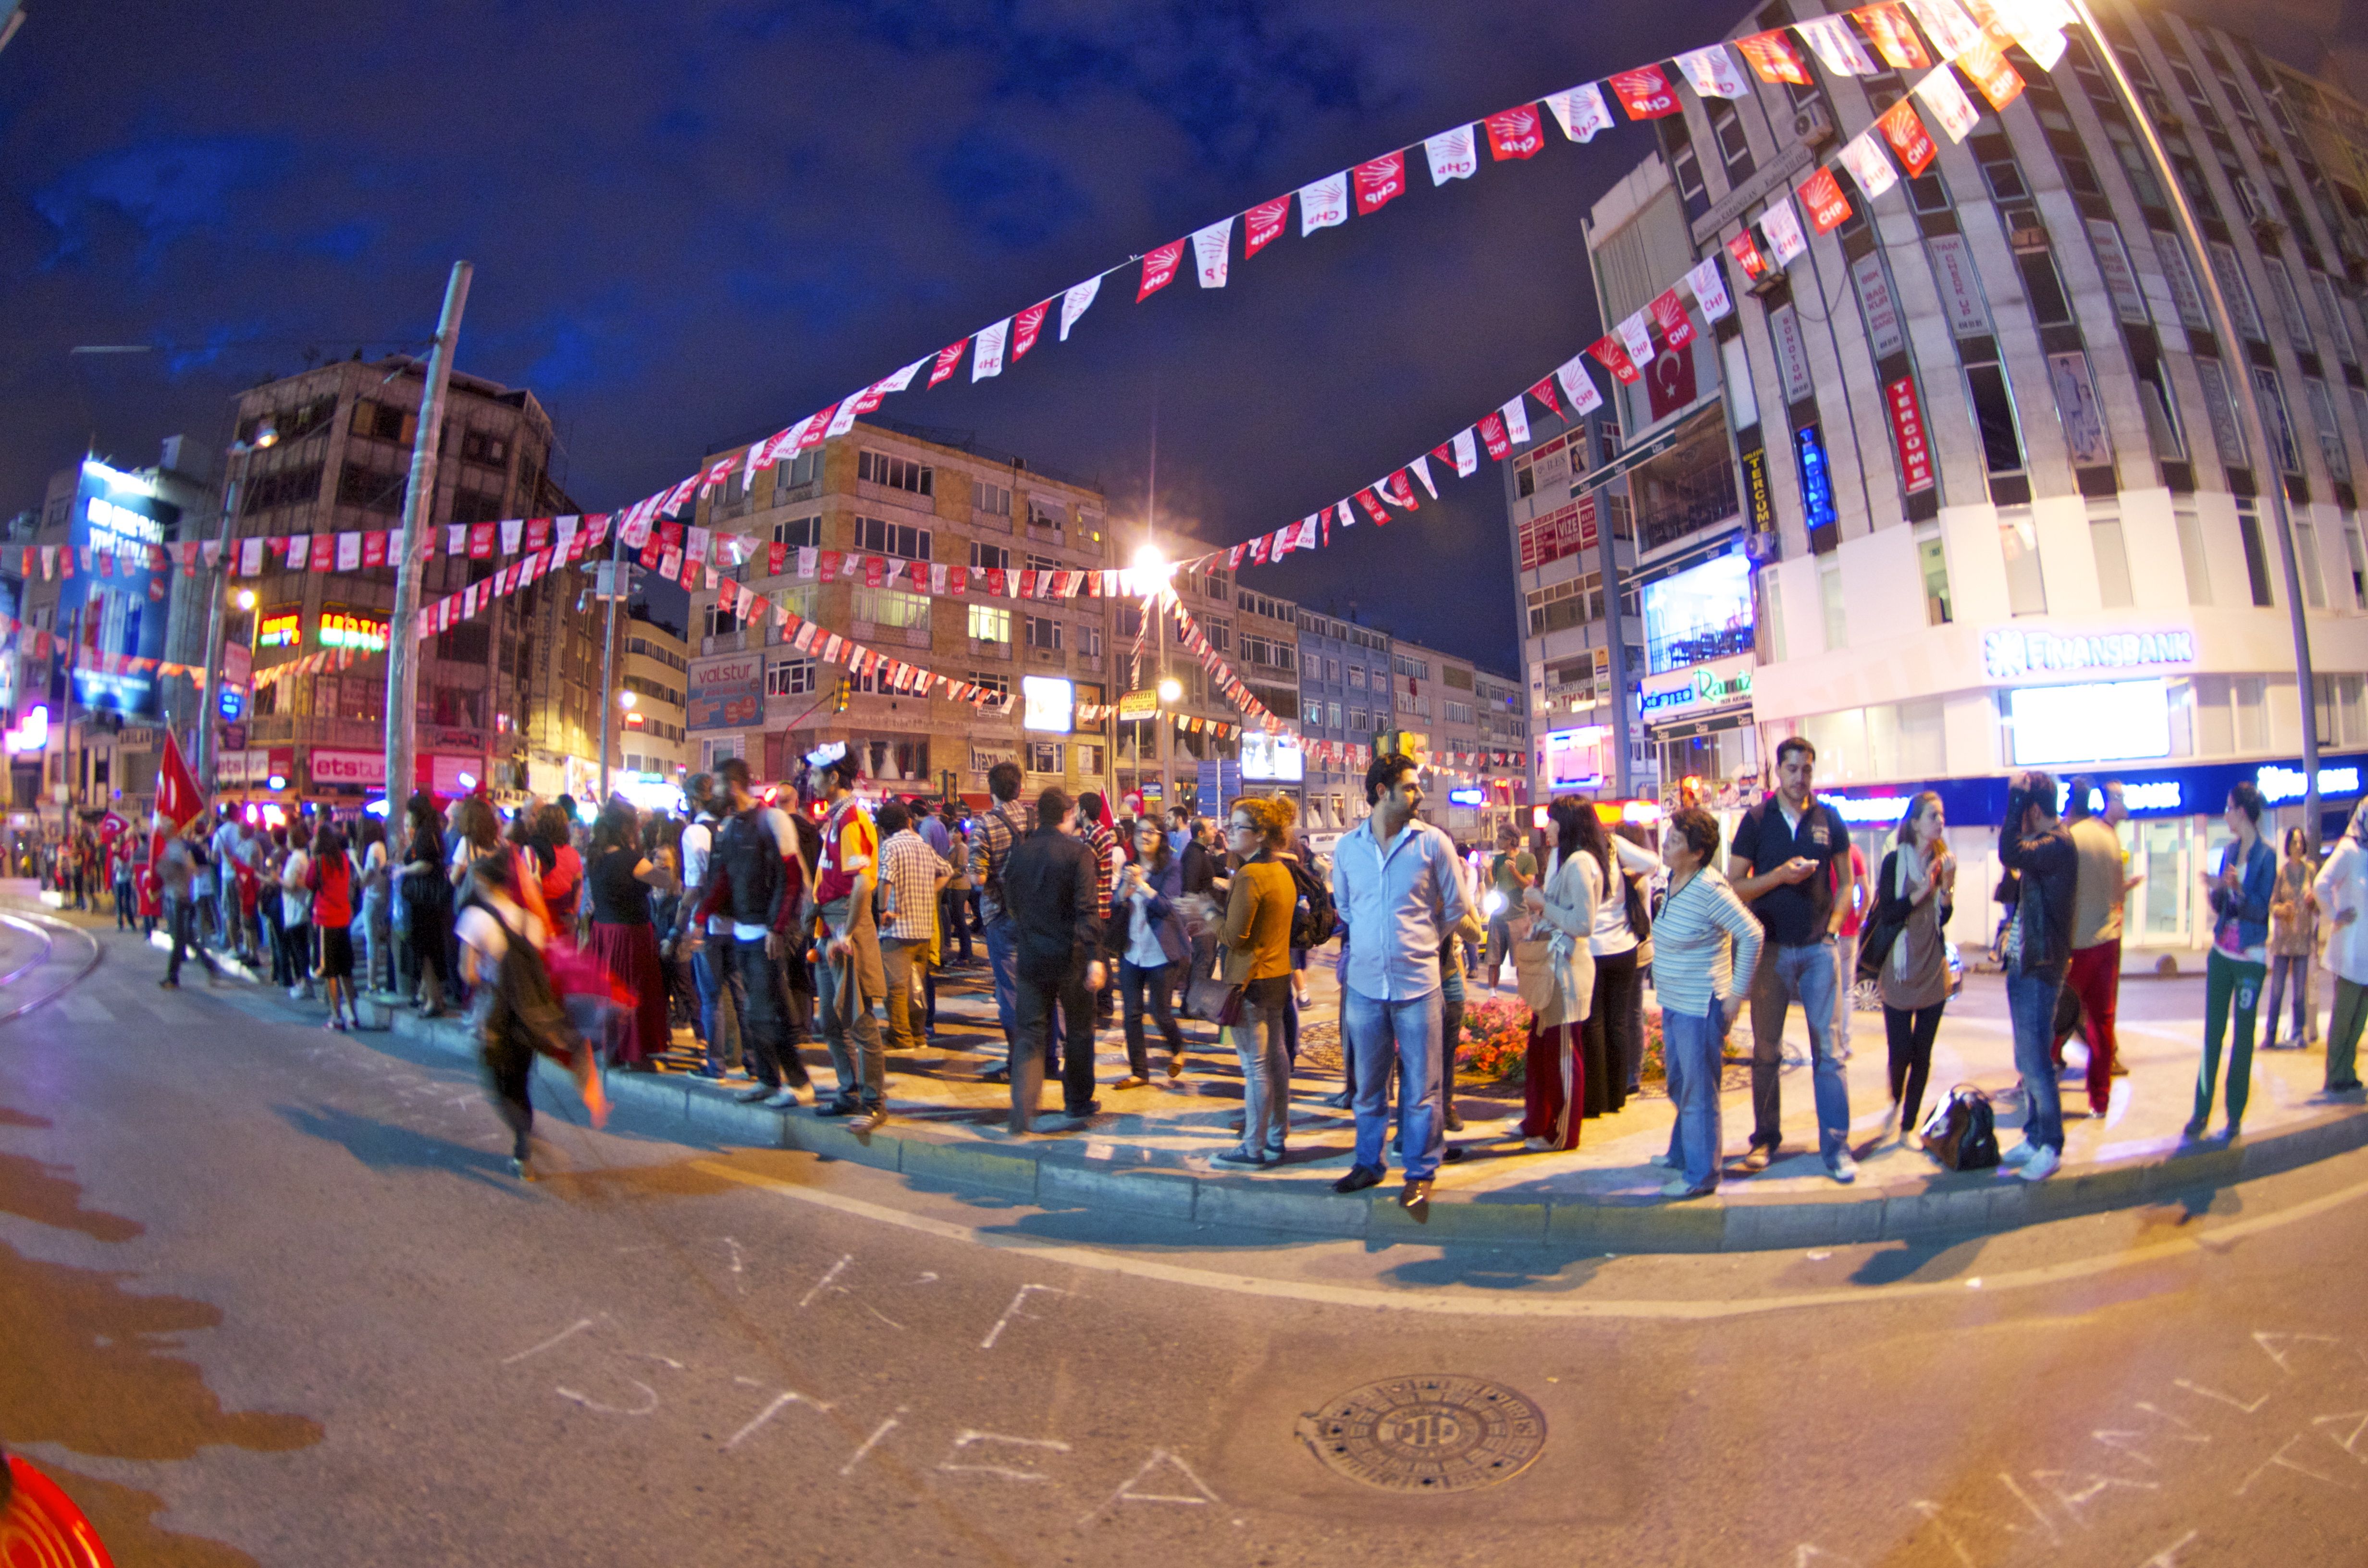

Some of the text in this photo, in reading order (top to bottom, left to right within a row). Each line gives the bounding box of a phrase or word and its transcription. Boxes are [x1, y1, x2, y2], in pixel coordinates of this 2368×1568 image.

[1989, 70, 2015, 97] CHP
[1907, 137, 1928, 165] CHP
[1862, 166, 1886, 189] CHP
[1818, 201, 1843, 226] CHP
[1777, 233, 1798, 257] CHP
[1704, 294, 1723, 312] CHP
[1669, 323, 1690, 345] CHP
[1631, 341, 1649, 358] CHP
[1618, 365, 1634, 379] CHP
[1575, 390, 1594, 407] CHP
[1489, 441, 1507, 455] CHP
[473, 544, 490, 553] CHP
[1693, 667, 1753, 704] Ramiz
[1561, 691, 1585, 707] THY
